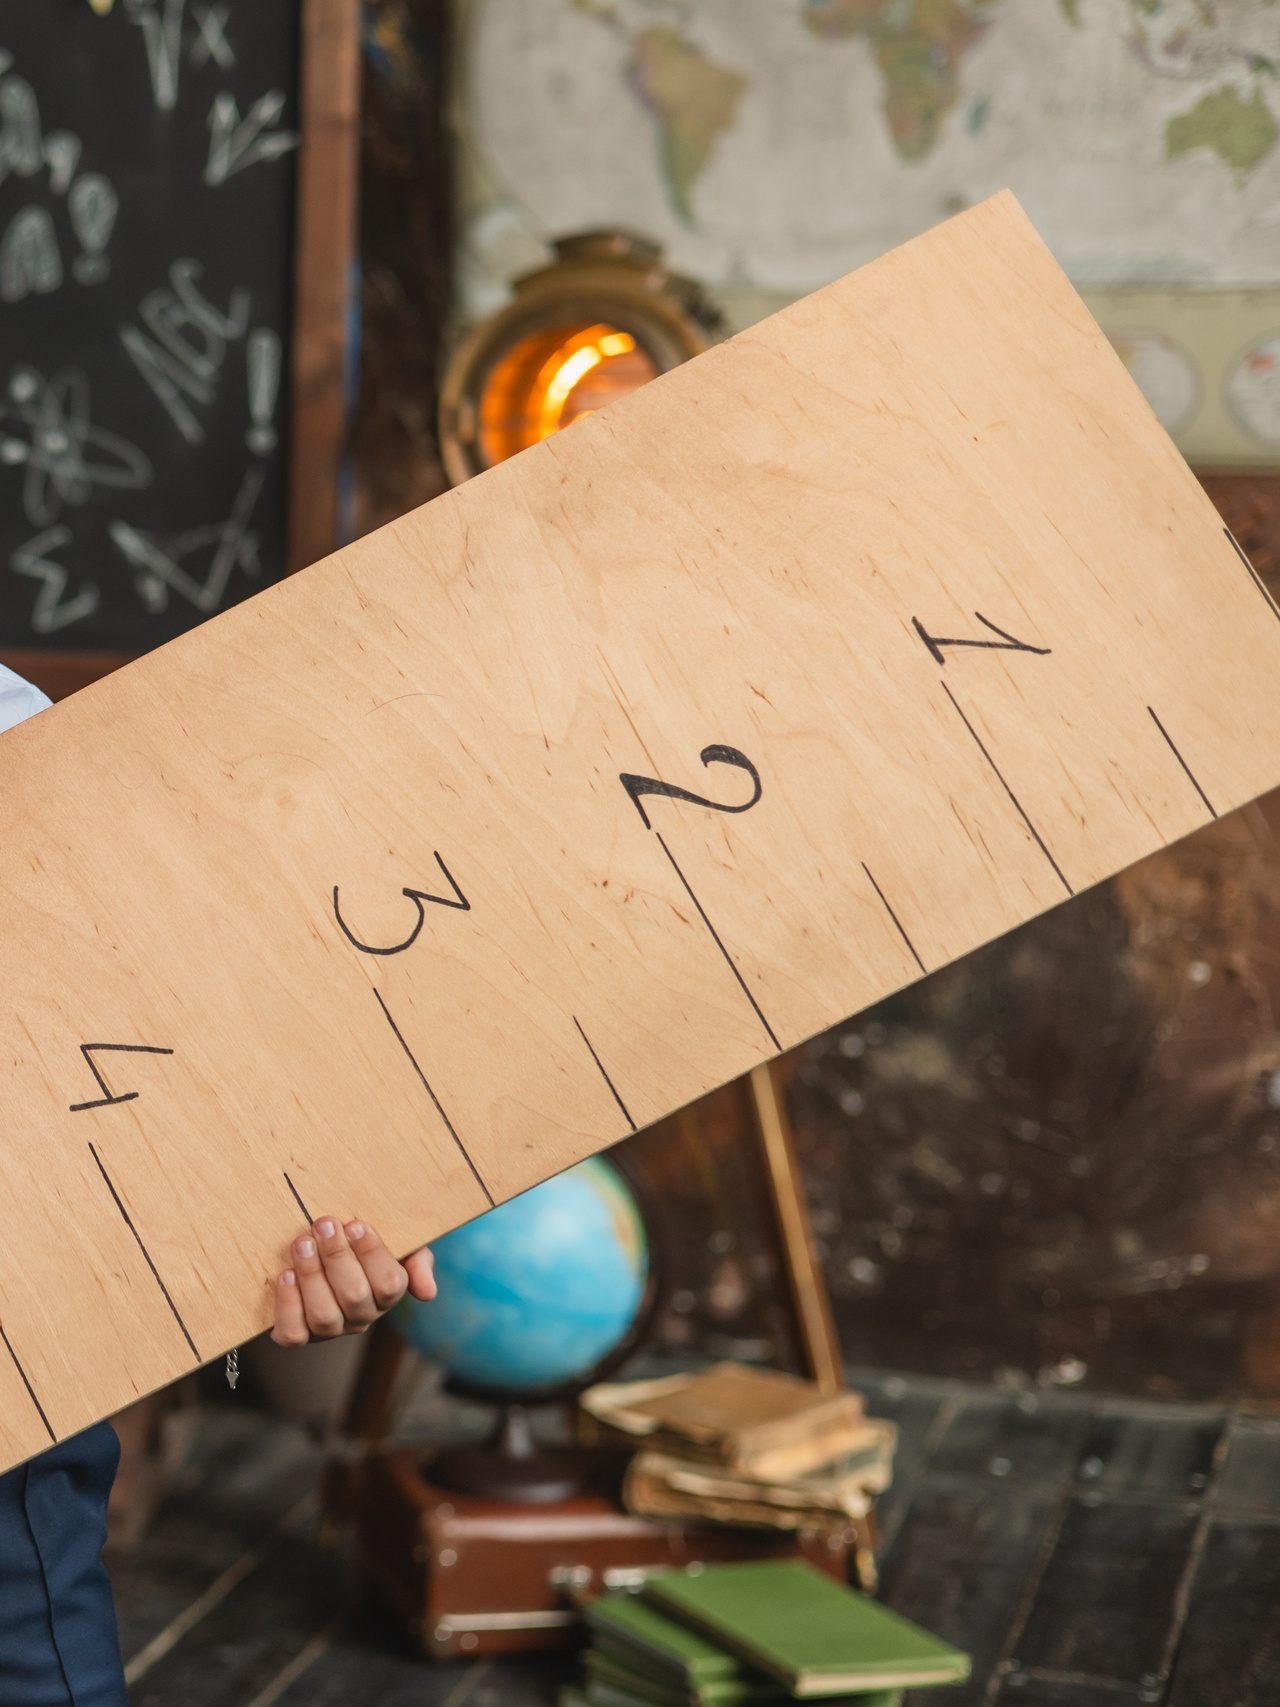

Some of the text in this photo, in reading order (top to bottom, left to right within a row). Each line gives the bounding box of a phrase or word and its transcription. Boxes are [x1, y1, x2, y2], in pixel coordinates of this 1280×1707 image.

[911, 611, 1052, 665] 1
[619, 743, 763, 831] 2
[333, 849, 471, 957] 3
[69, 1042, 175, 1113] 4
